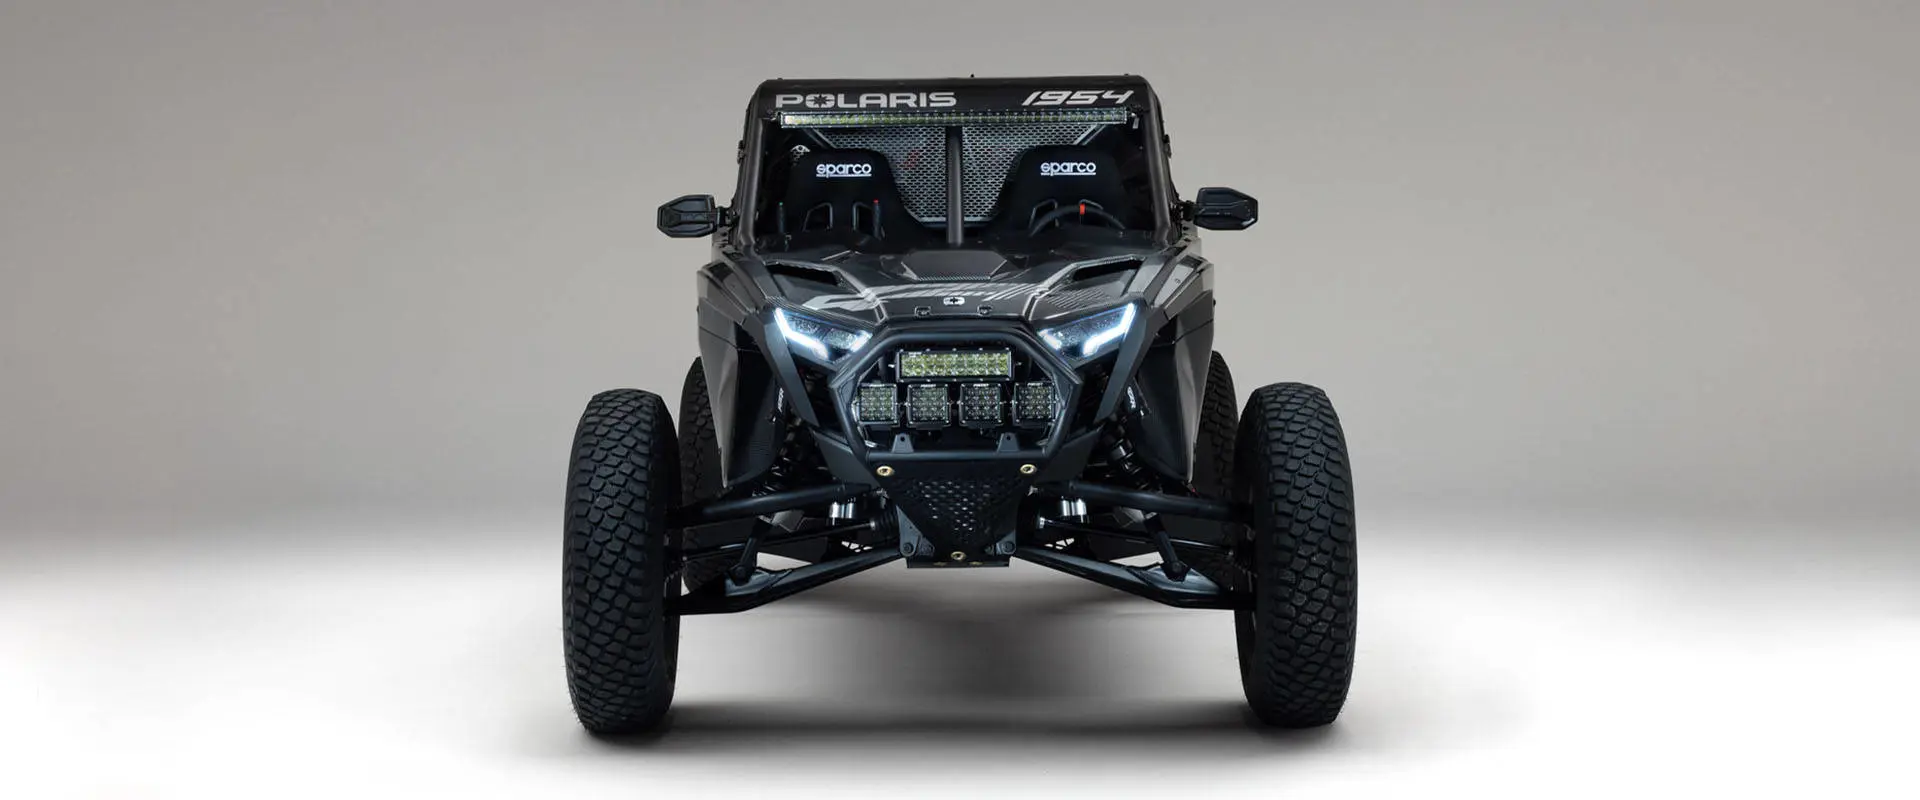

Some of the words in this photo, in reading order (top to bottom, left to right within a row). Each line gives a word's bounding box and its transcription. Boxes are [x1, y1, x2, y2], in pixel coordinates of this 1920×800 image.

[775, 92, 957, 109] POLARIS
[1021, 90, 1134, 106] 1954
[816, 163, 872, 178] sparco
[1040, 161, 1097, 176] sparco
